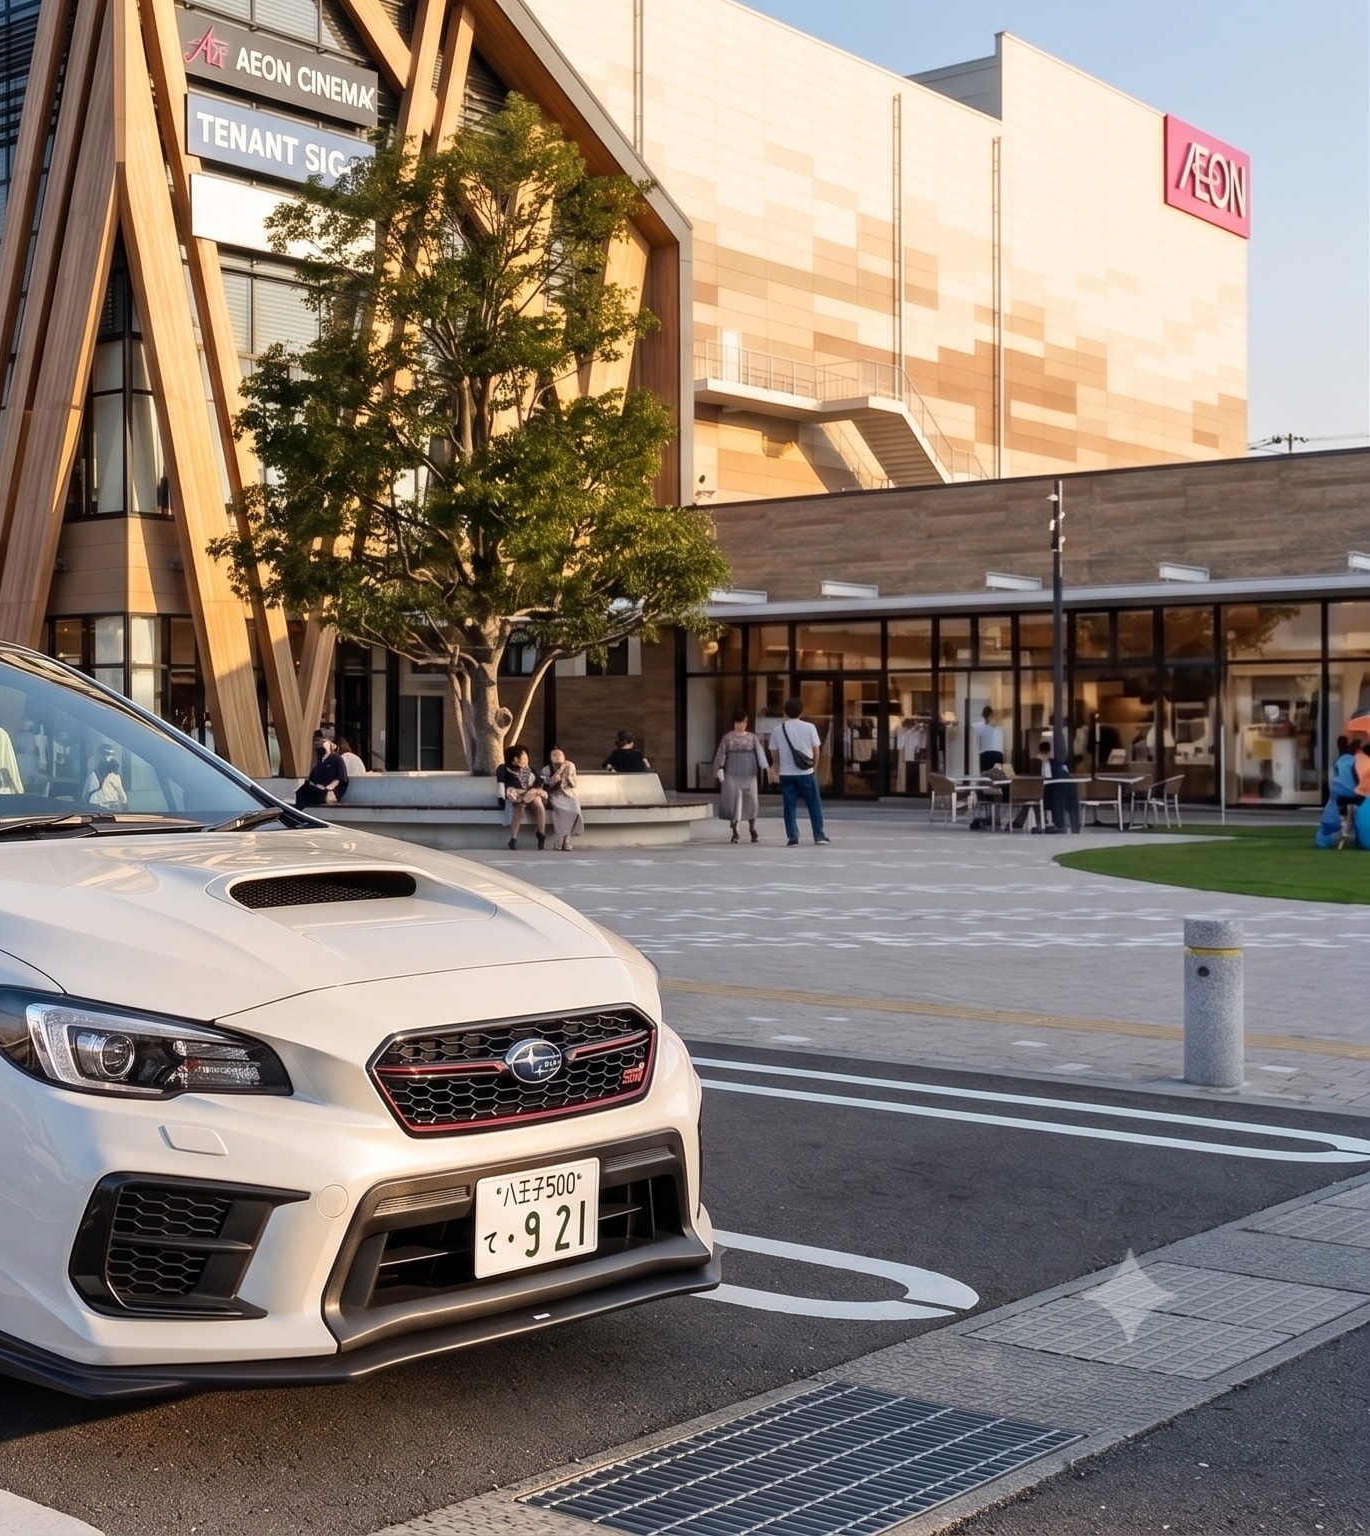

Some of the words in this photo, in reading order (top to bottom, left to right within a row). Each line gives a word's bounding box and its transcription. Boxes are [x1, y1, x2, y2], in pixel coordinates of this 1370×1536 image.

[235, 47, 291, 87] AEON
[196, 111, 299, 166] TENANT
[305, 143, 362, 183] SIG
